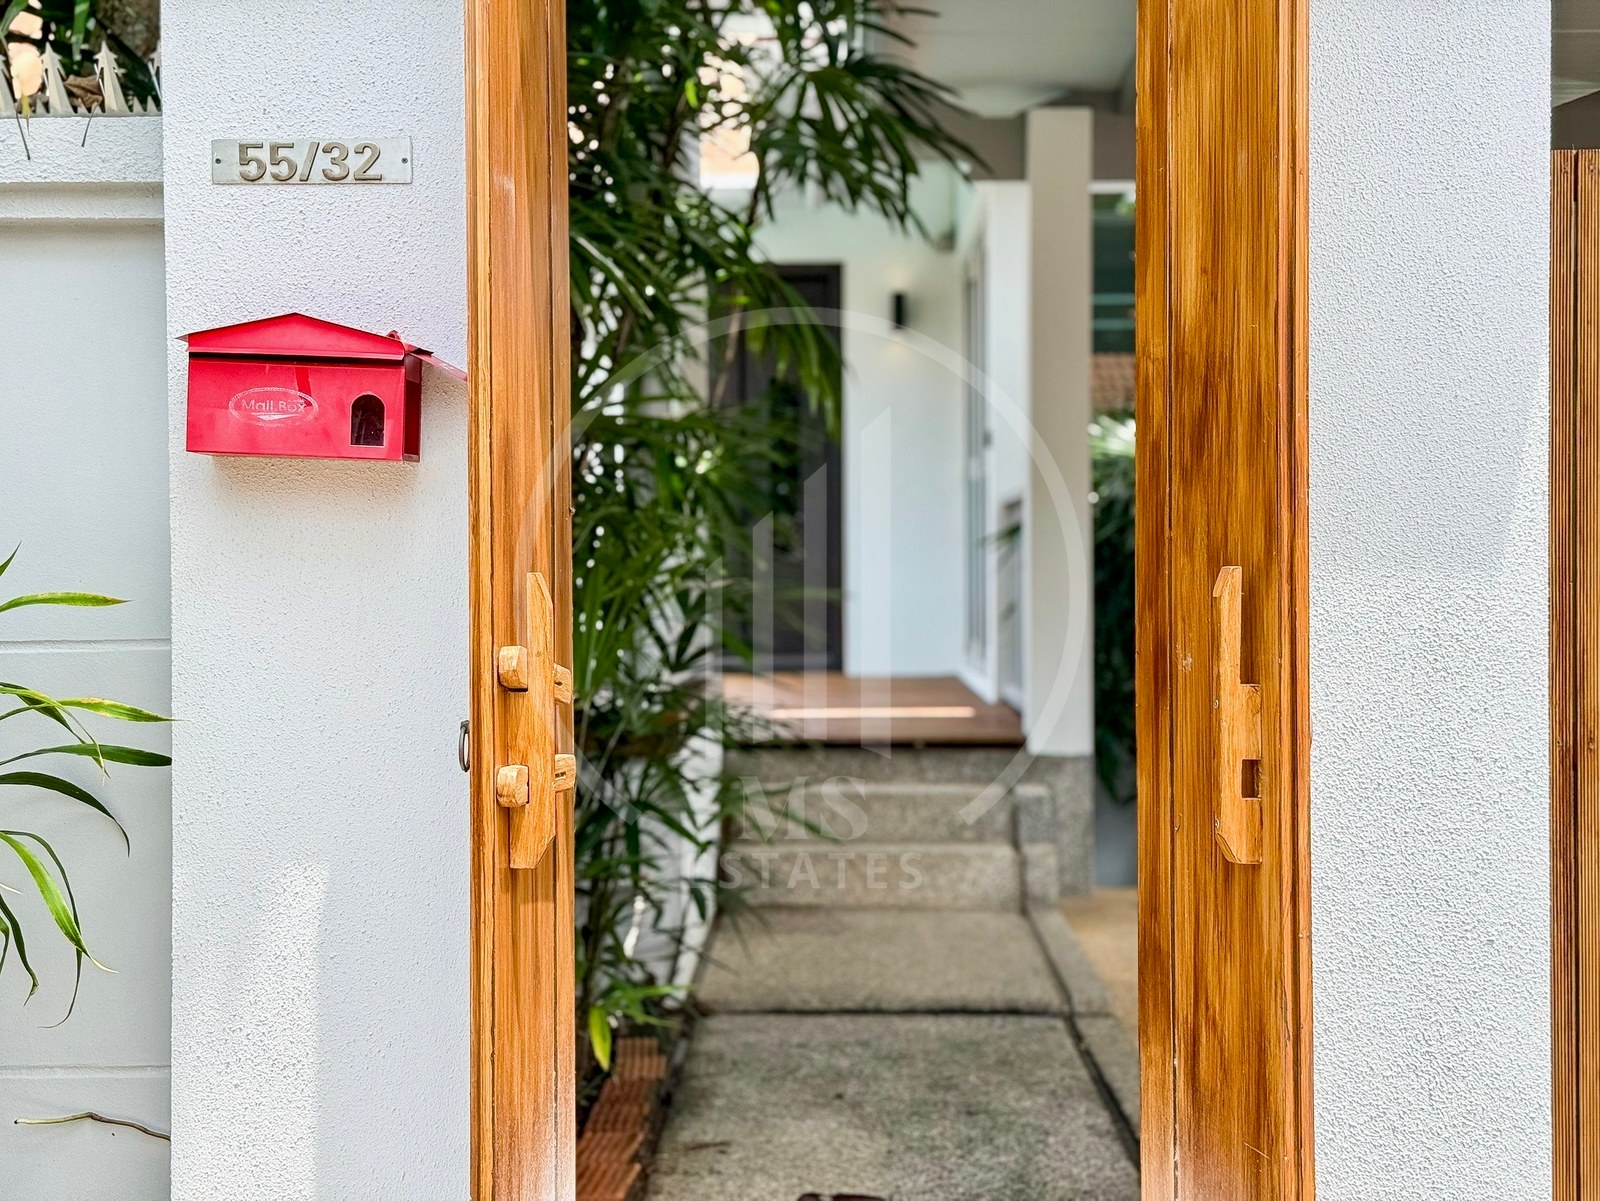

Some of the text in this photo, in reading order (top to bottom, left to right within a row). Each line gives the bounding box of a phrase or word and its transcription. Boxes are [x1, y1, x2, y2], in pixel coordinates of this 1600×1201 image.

[238, 141, 382, 181] 55/32
[241, 399, 307, 412] Mail Box
